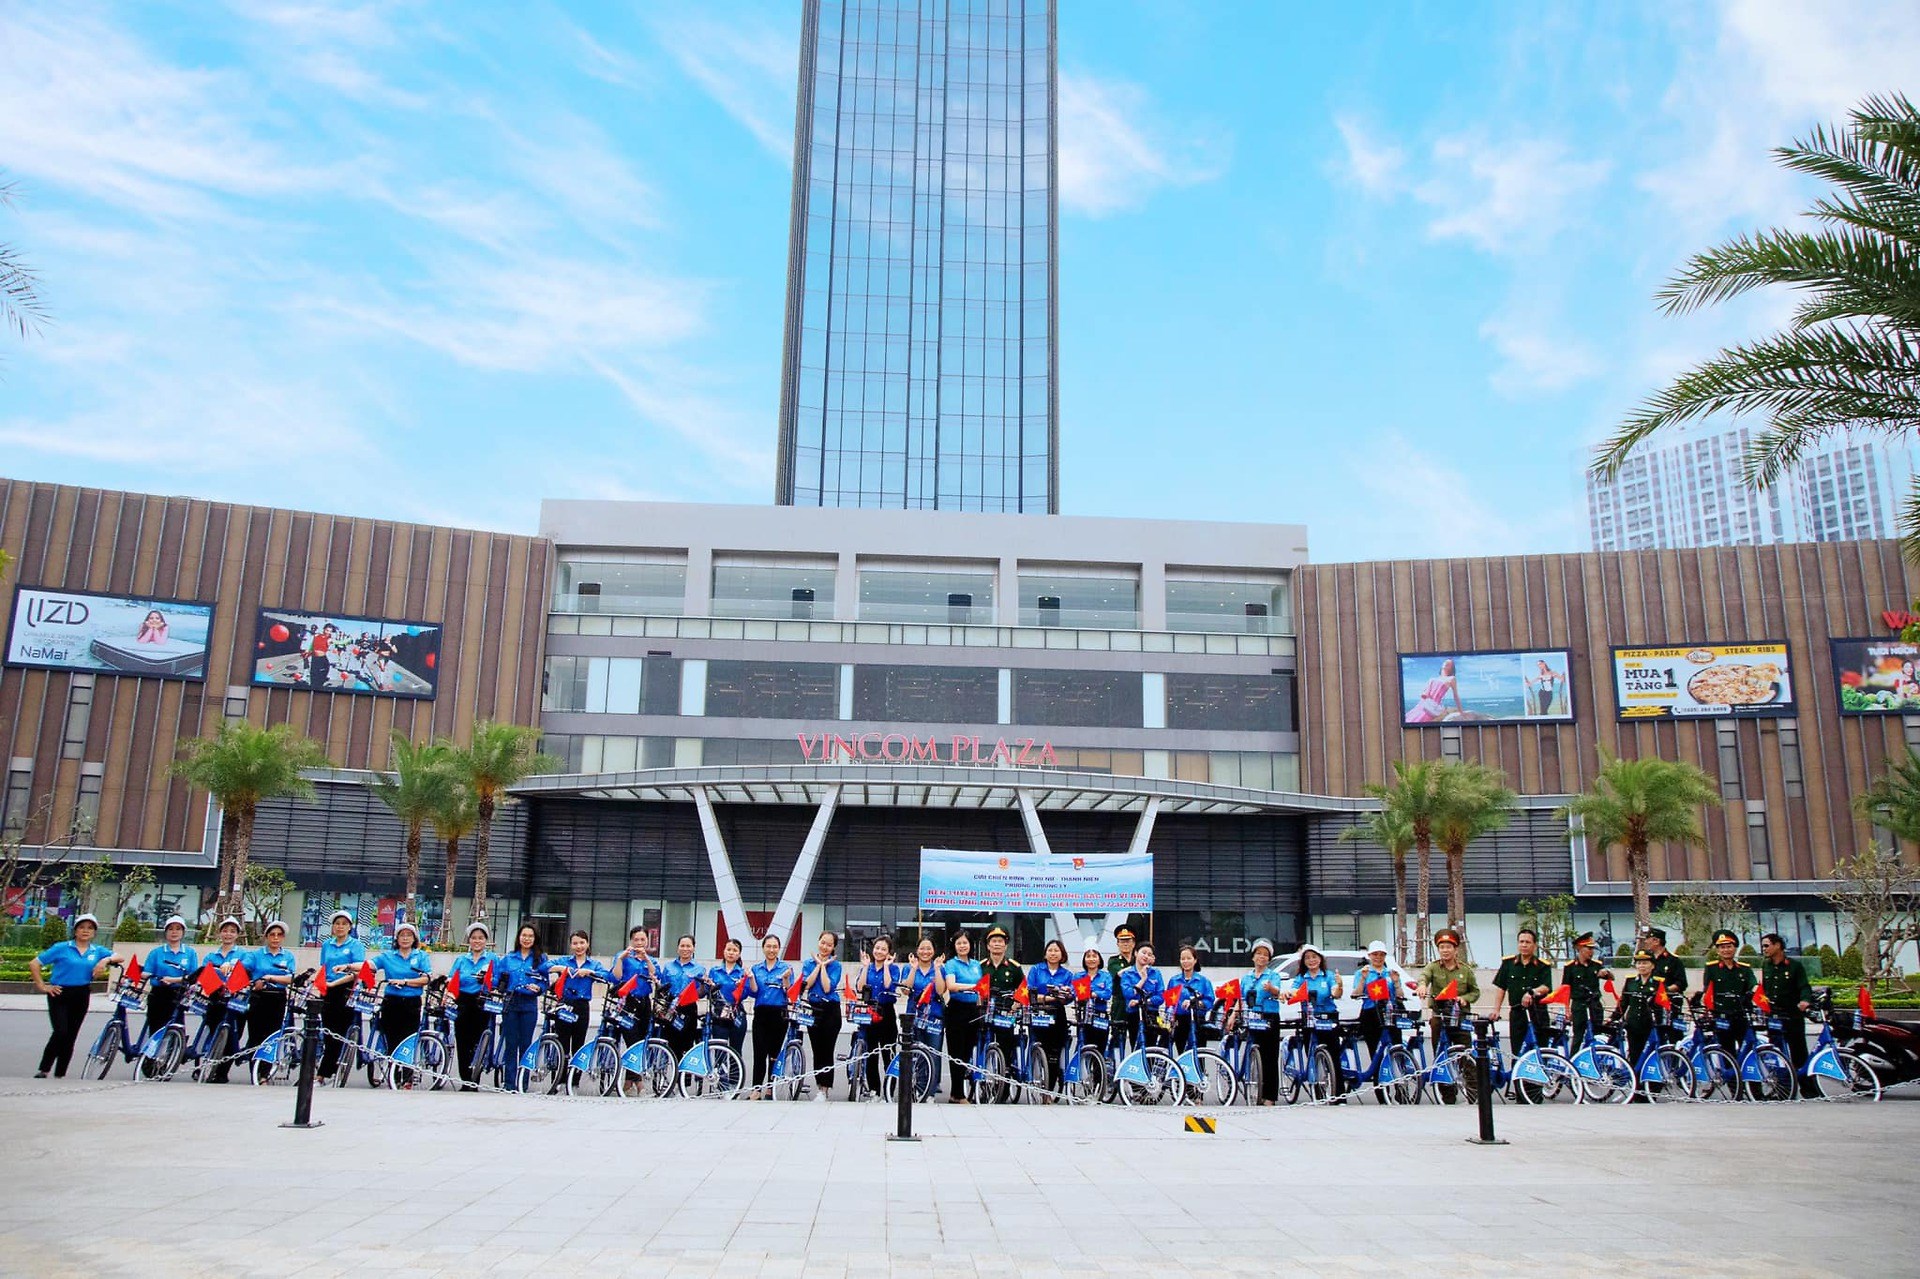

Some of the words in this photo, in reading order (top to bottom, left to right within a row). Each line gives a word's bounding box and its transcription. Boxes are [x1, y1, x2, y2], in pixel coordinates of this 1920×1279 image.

[20, 645, 68, 660] NaMat
[1624, 668, 1662, 678] MUA
[1664, 668, 1677, 688] 1
[795, 733, 938, 761] VINCOM
[951, 735, 1058, 765] PLAZA
[1194, 937, 1253, 953] ALD
